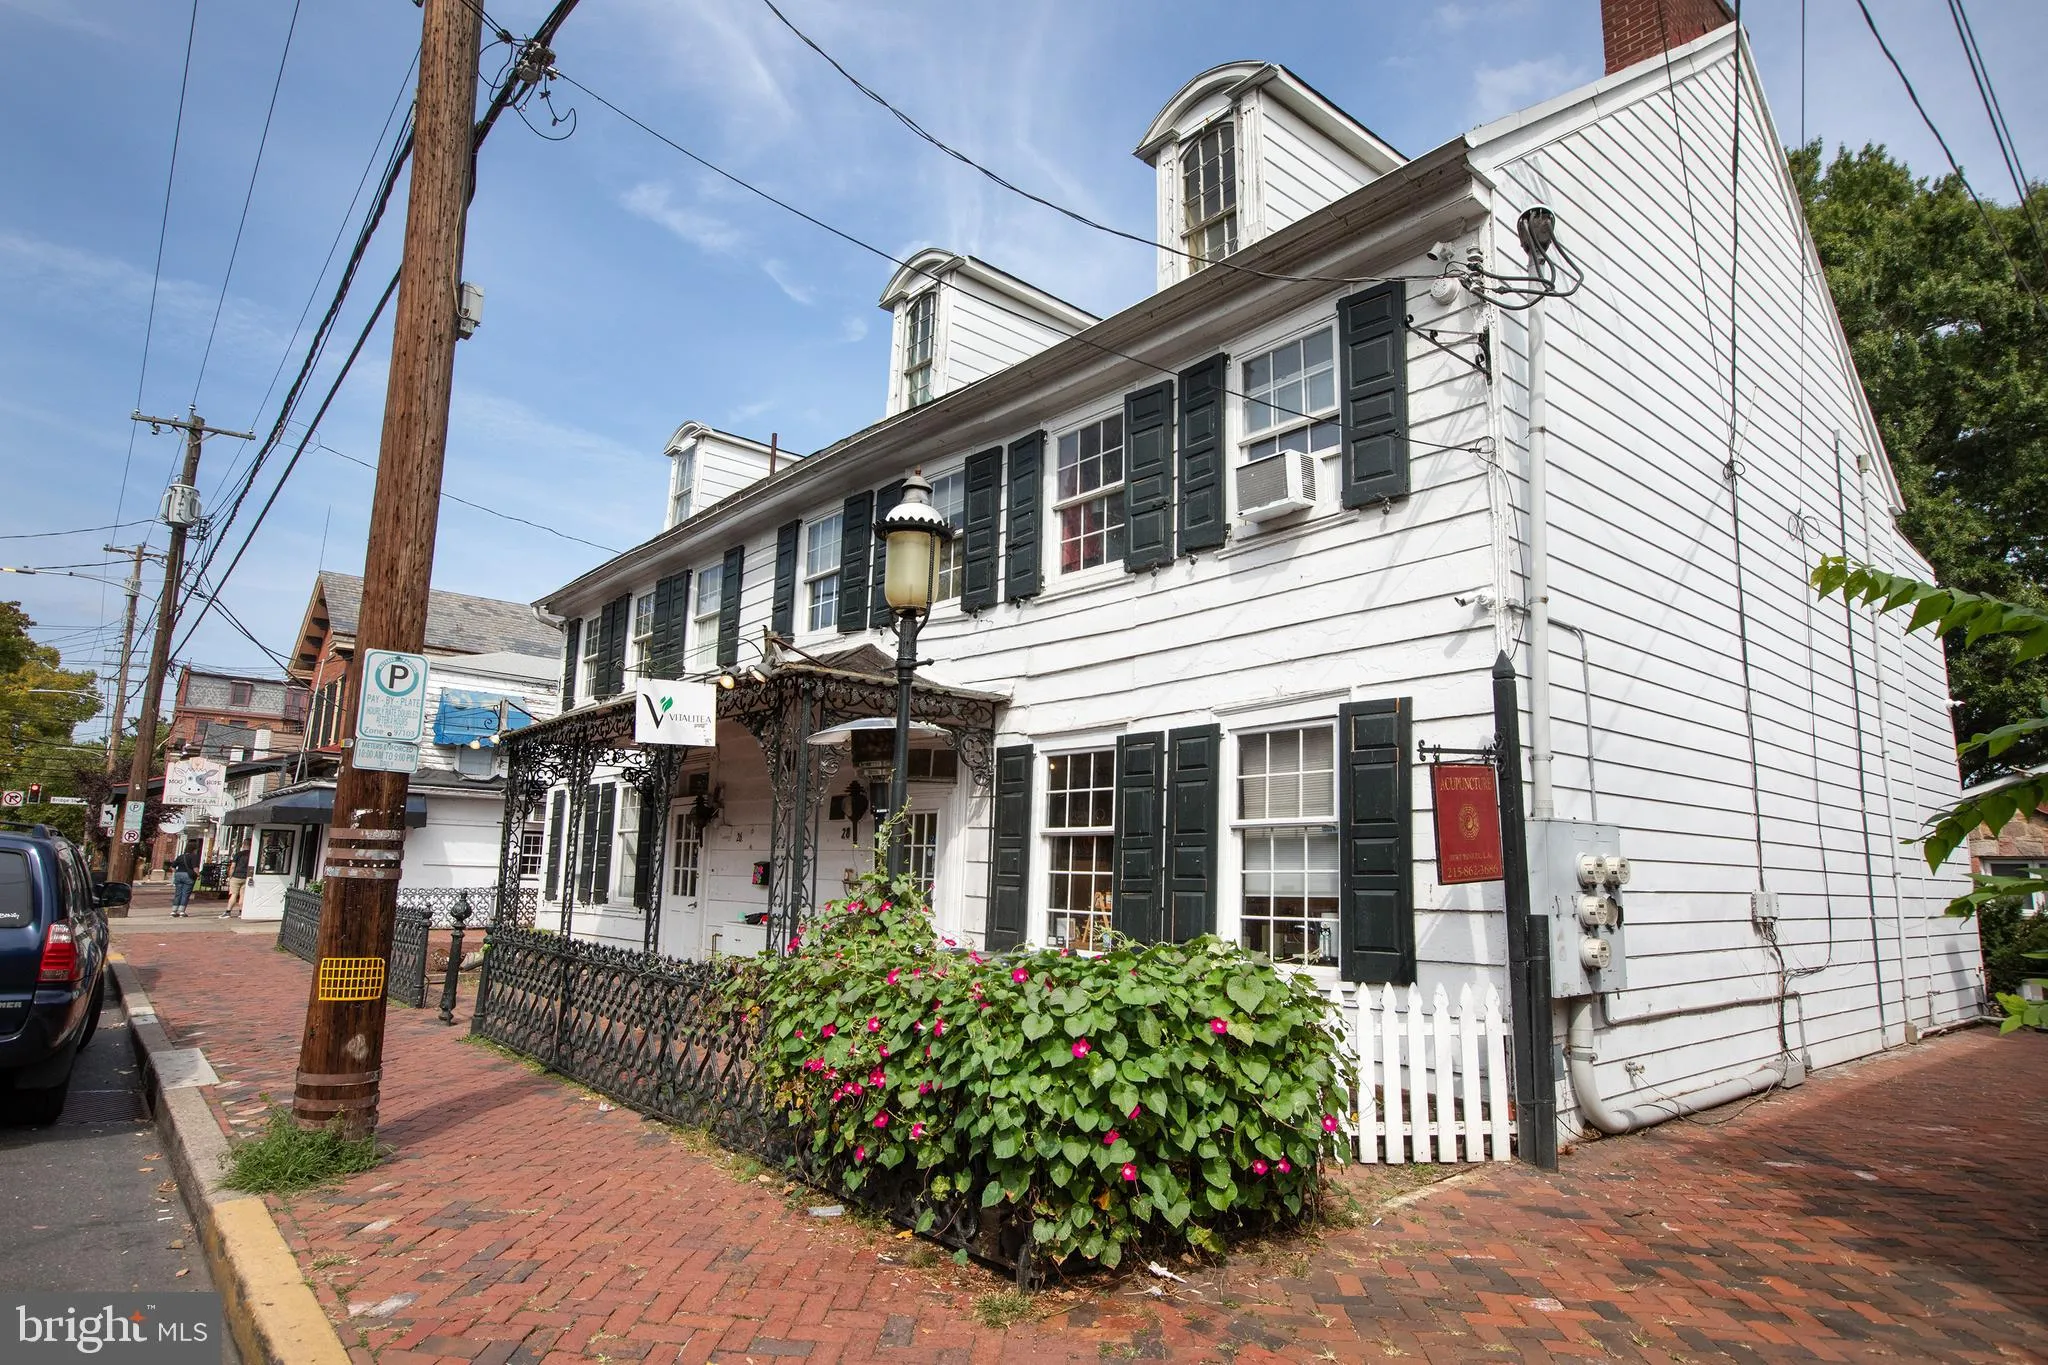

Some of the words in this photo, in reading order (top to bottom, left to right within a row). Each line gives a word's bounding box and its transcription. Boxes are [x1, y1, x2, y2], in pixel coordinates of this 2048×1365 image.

[388, 664, 409, 689] P
[366, 693, 380, 703] PAY
[385, 696, 395, 705] BY
[400, 697, 420, 708] PLATE
[669, 713, 712, 724] VITALITEA
[364, 726, 384, 735] Zone
[393, 729, 415, 738] 97103
[361, 742, 383, 750] METERS
[384, 743, 414, 753] ENFORCED
[374, 750, 384, 760] AM
[385, 752, 393, 761] TO
[406, 753, 416, 763] PM
[1440, 775, 1493, 791] ACUPUNCTURE
[185, 797, 217, 805] CREAM
